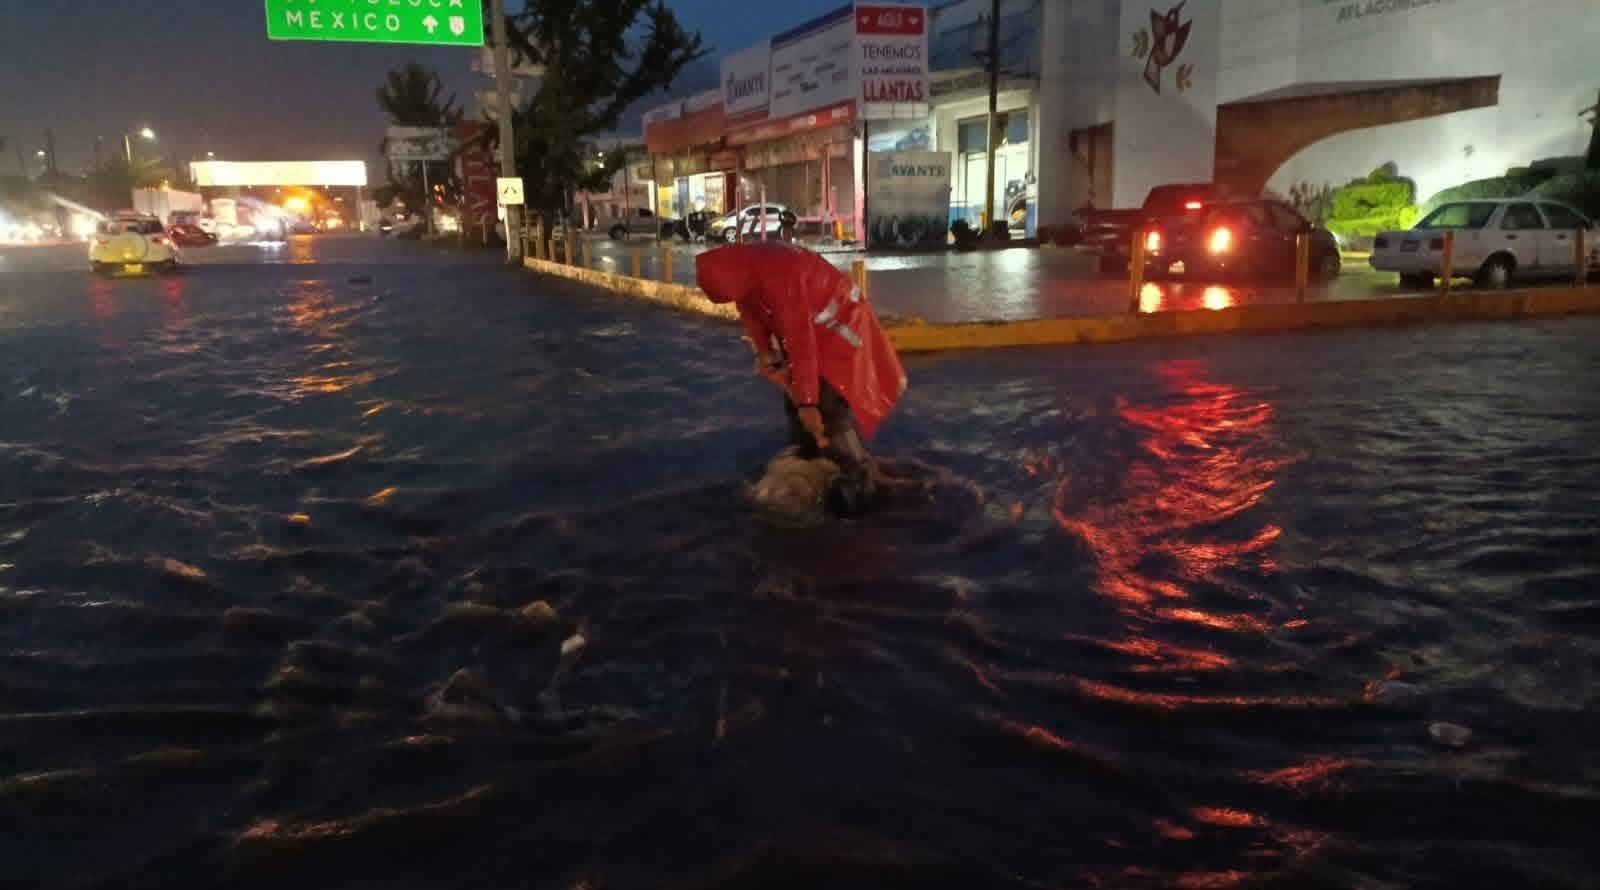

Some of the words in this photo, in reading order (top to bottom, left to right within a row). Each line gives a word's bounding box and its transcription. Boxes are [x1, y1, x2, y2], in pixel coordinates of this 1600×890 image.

[285, 11, 401, 32] MEXICO
[863, 45, 921, 59] TENEMOS
[863, 79, 922, 103] LLANTAS
[888, 164, 944, 177] AVANTE
